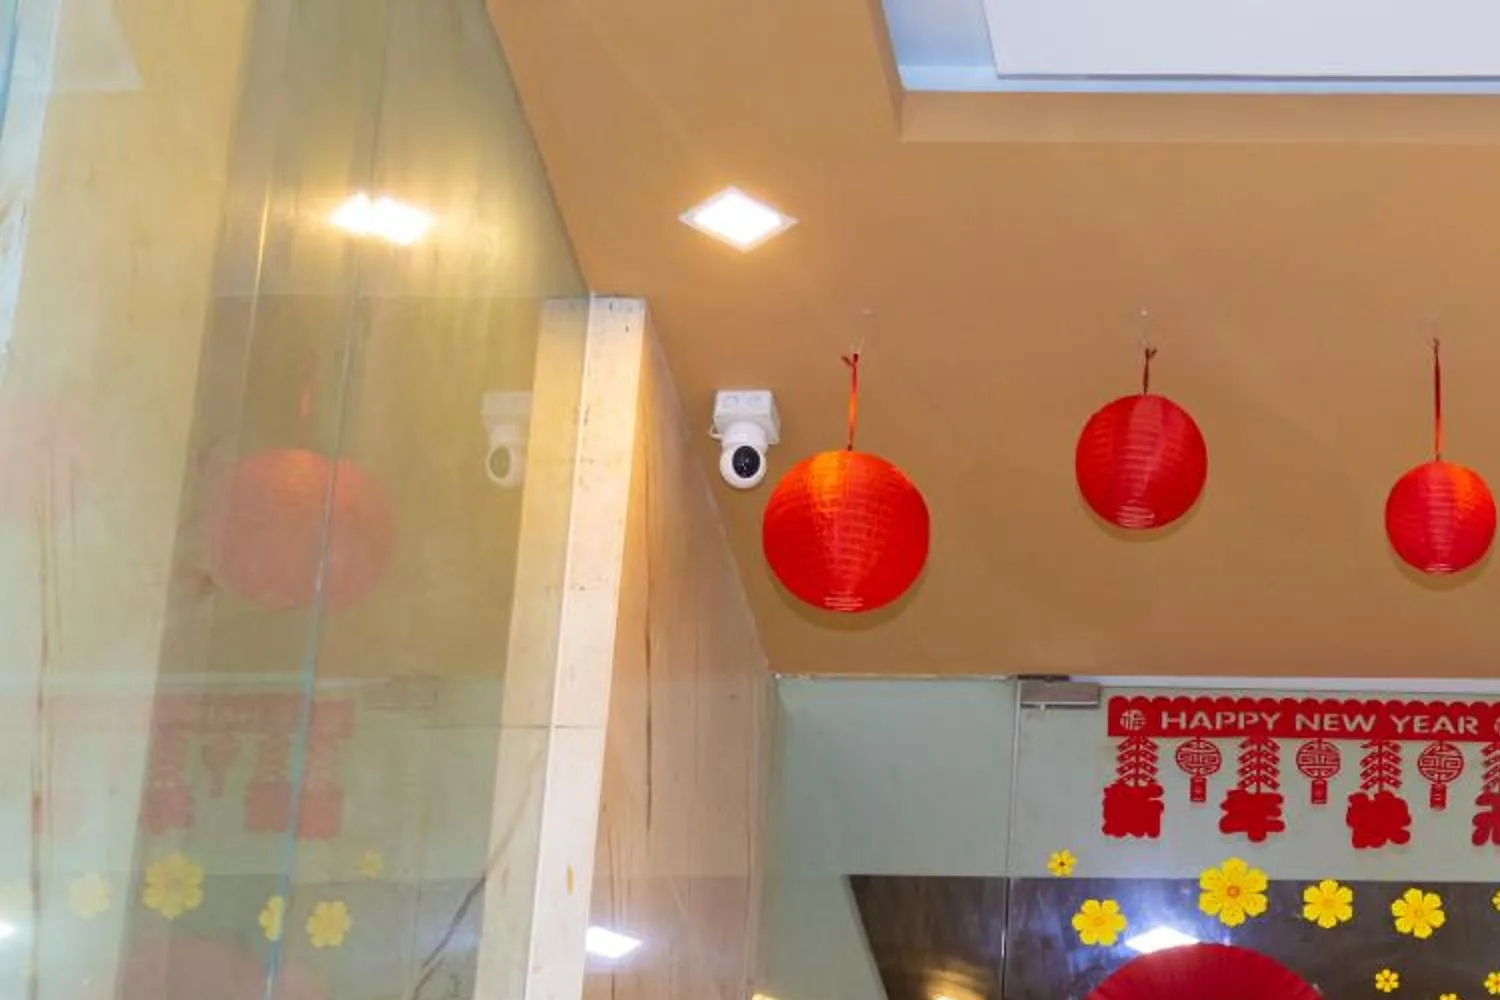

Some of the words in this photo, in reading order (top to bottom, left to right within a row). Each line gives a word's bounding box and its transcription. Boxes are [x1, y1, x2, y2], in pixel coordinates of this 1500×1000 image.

[1160, 710, 1282, 733] HAPPY
[1295, 713, 1376, 733] NEW
[1389, 715, 1479, 735] YEAR
